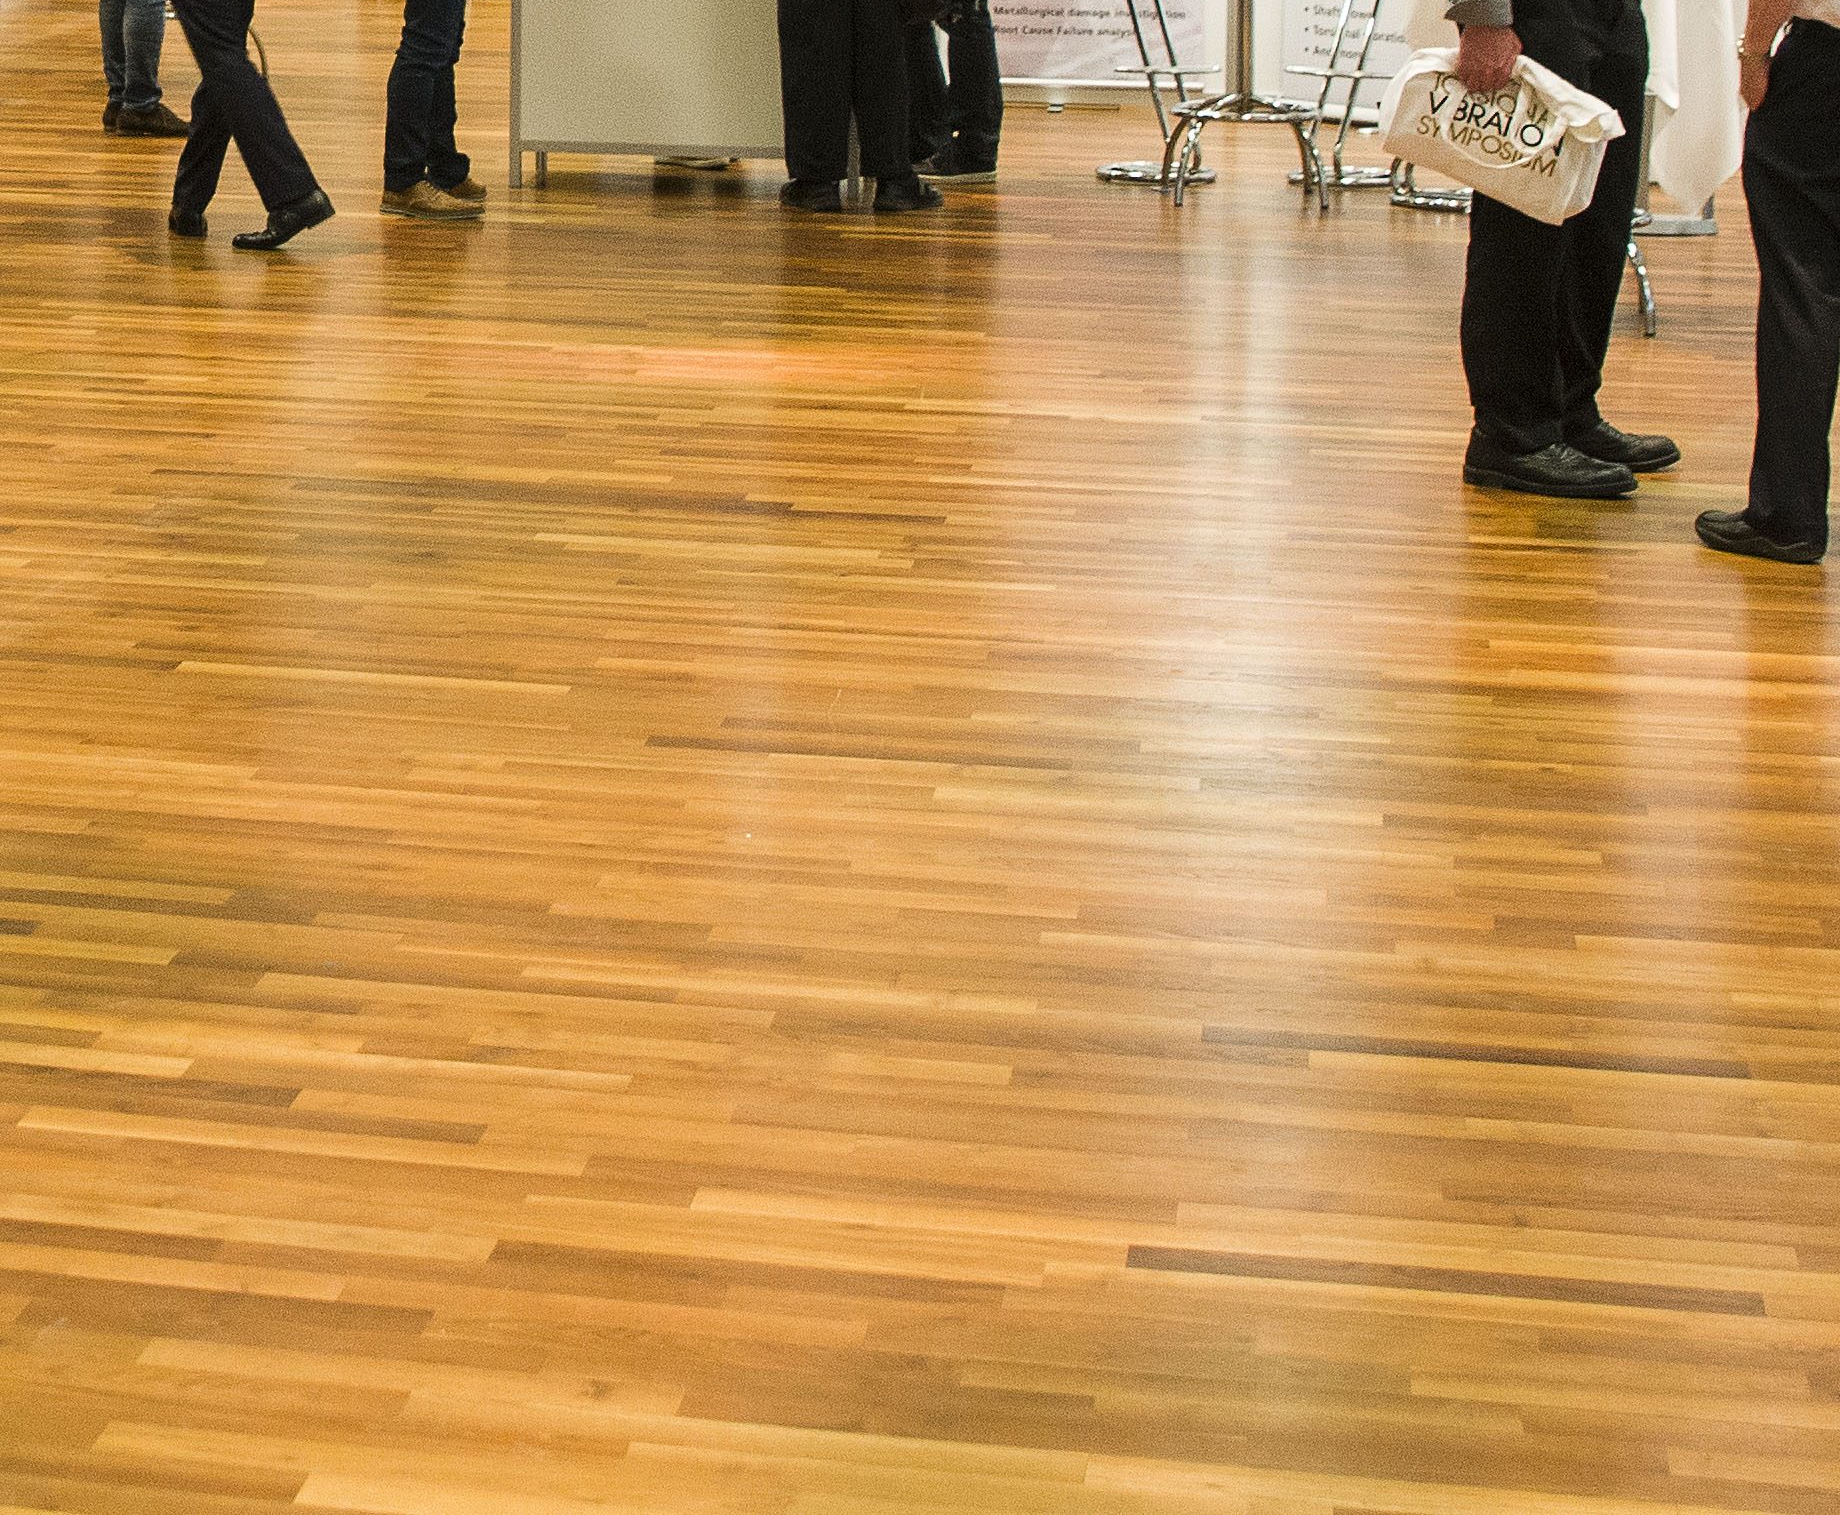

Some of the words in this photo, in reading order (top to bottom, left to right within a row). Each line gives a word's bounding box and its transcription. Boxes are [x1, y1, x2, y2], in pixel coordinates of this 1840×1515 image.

[994, 7, 1065, 19] Metallurgical
[1067, 8, 1111, 19] damage
[1022, 25, 1053, 35] Cause
[1057, 26, 1093, 36] Failure
